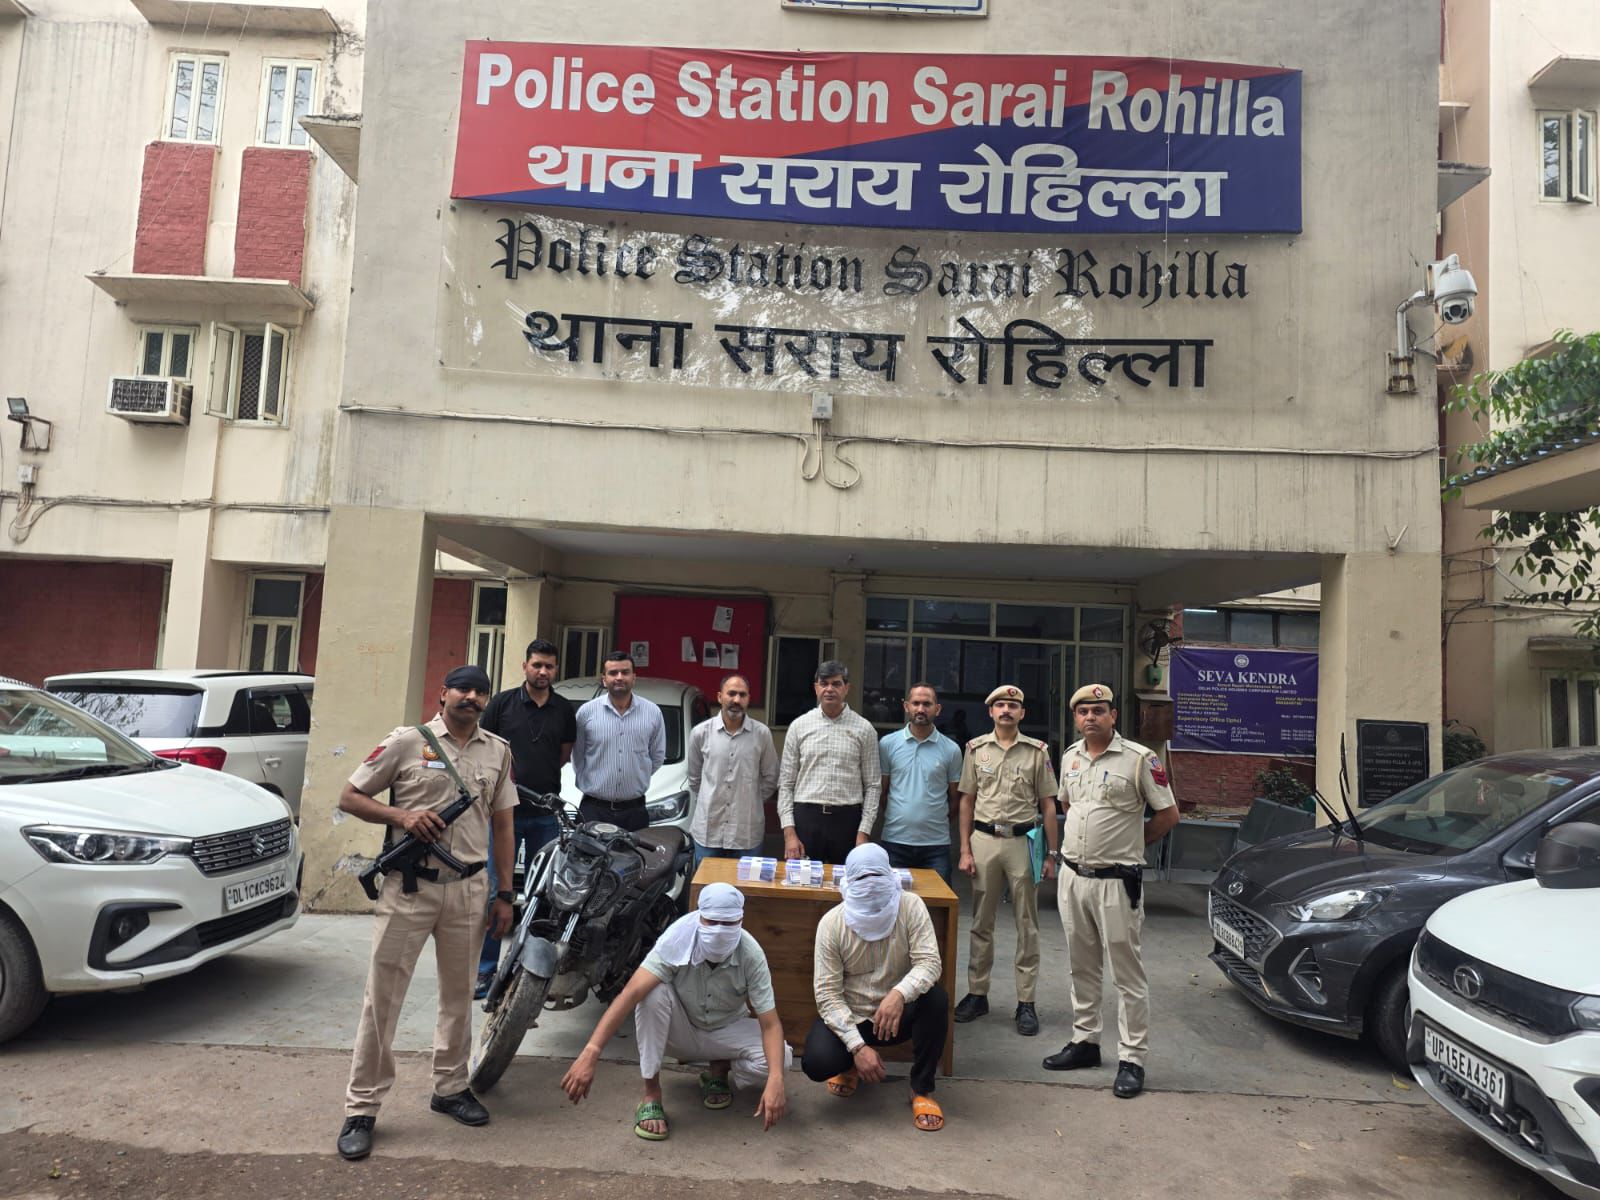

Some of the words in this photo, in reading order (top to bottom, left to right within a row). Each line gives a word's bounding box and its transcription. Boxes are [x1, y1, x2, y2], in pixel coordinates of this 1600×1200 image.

[476, 53, 656, 115] Police
[675, 60, 889, 124] Station
[910, 66, 1067, 129] Sarai
[1087, 69, 1286, 137] Rohilla
[527, 145, 702, 200] थाना
[719, 155, 921, 212] सराय
[939, 143, 1229, 222] रोहिल्ला
[490, 217, 658, 281] Police
[674, 233, 867, 294] Station
[883, 244, 1034, 299] Sarai
[1053, 248, 1250, 309] Rohilla
[521, 310, 693, 370] थाना
[714, 323, 906, 383] सराय
[926, 316, 1215, 389] रोहिल्ला
[1198, 670, 1234, 682] SEVA
[1238, 672, 1297, 685] KENDRA
[233, 874, 285, 904] DL1CAC9624
[1432, 1035, 1503, 1100] UP15EA4361
